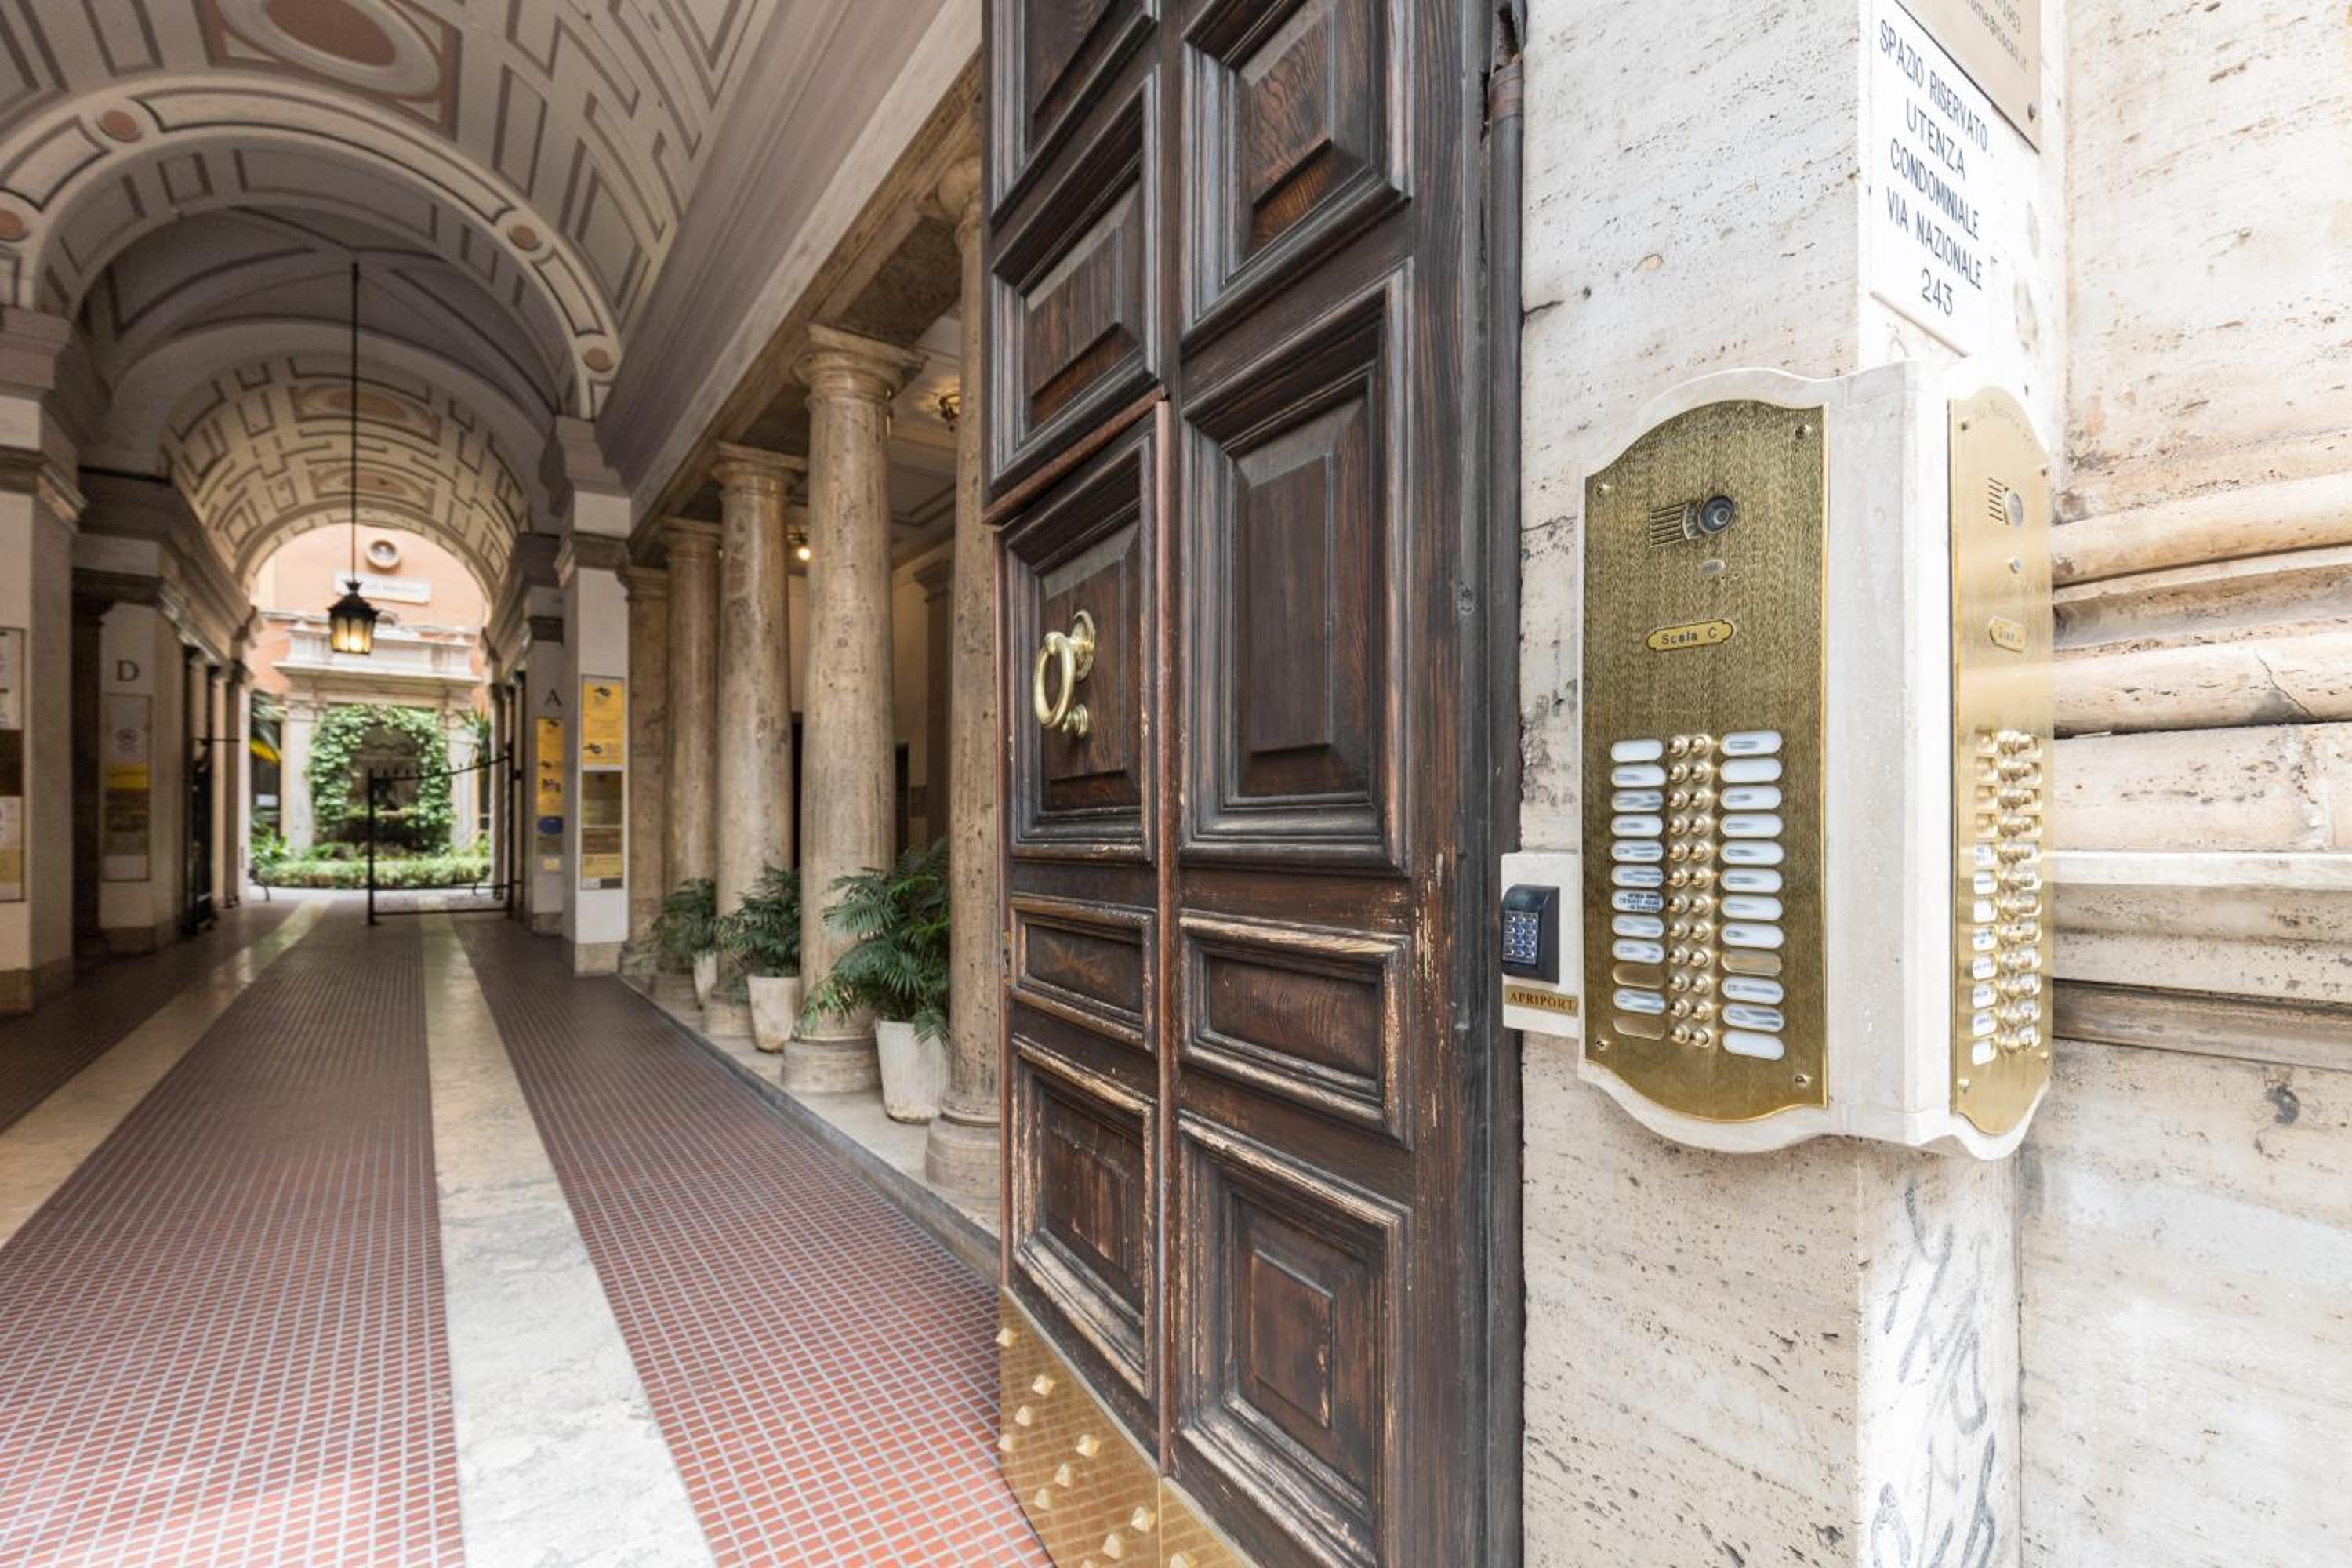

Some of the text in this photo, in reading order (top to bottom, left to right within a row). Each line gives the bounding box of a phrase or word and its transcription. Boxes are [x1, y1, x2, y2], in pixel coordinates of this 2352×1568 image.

[1880, 19, 1987, 152] SPAZIO RISERVATO
[1906, 97, 1965, 181] UTENZA
[1890, 137, 1979, 241] CONDOMINIALE
[1886, 185, 1983, 291] VIA NAZIONALE
[1921, 267, 1953, 316] 243
[1661, 626, 1718, 645] Scala C
[117, 659, 141, 682] D
[544, 688, 562, 706] A
